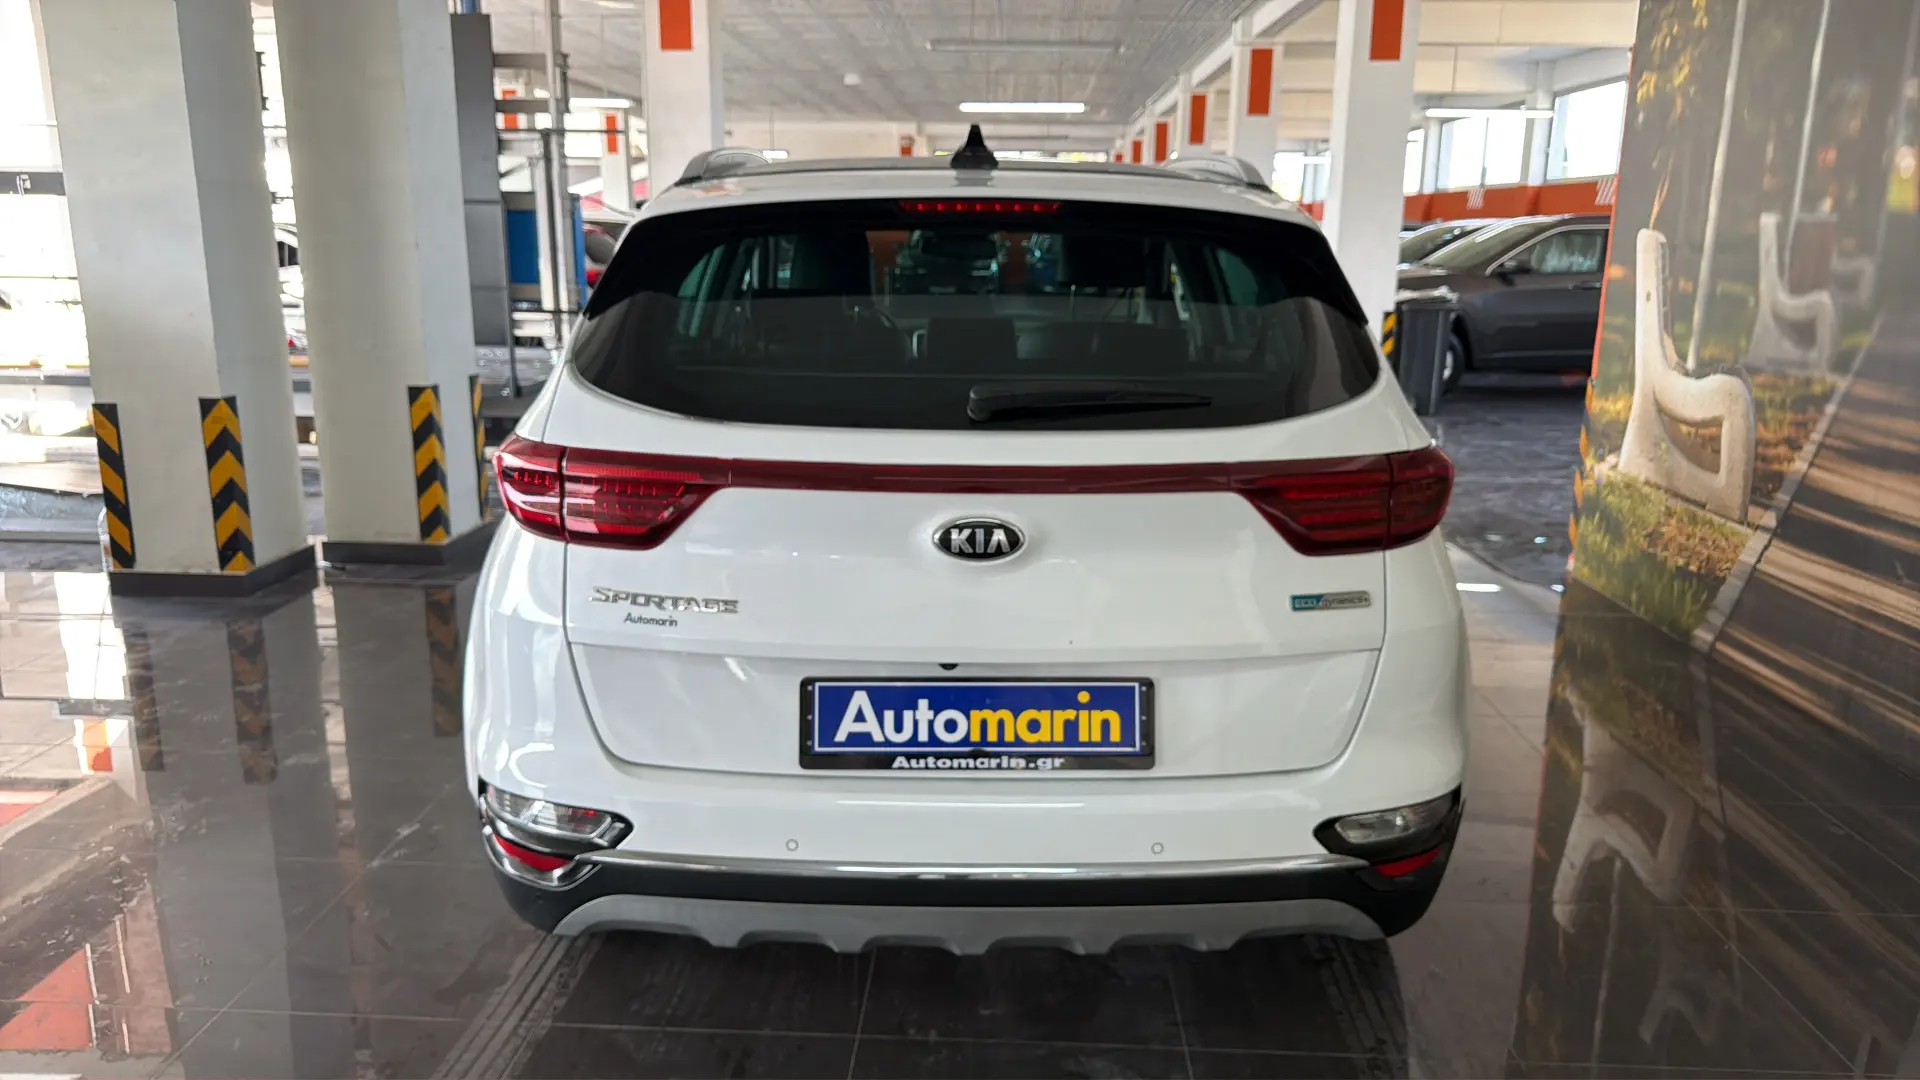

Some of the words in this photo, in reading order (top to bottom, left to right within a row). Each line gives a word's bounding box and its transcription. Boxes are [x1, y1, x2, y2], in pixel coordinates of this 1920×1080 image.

[950, 528, 1011, 553] KIA
[589, 586, 739, 613] SPORTAGE
[624, 612, 678, 627] Automarin
[833, 690, 1122, 742] Automarin
[891, 755, 1065, 770] Automarin.gr
